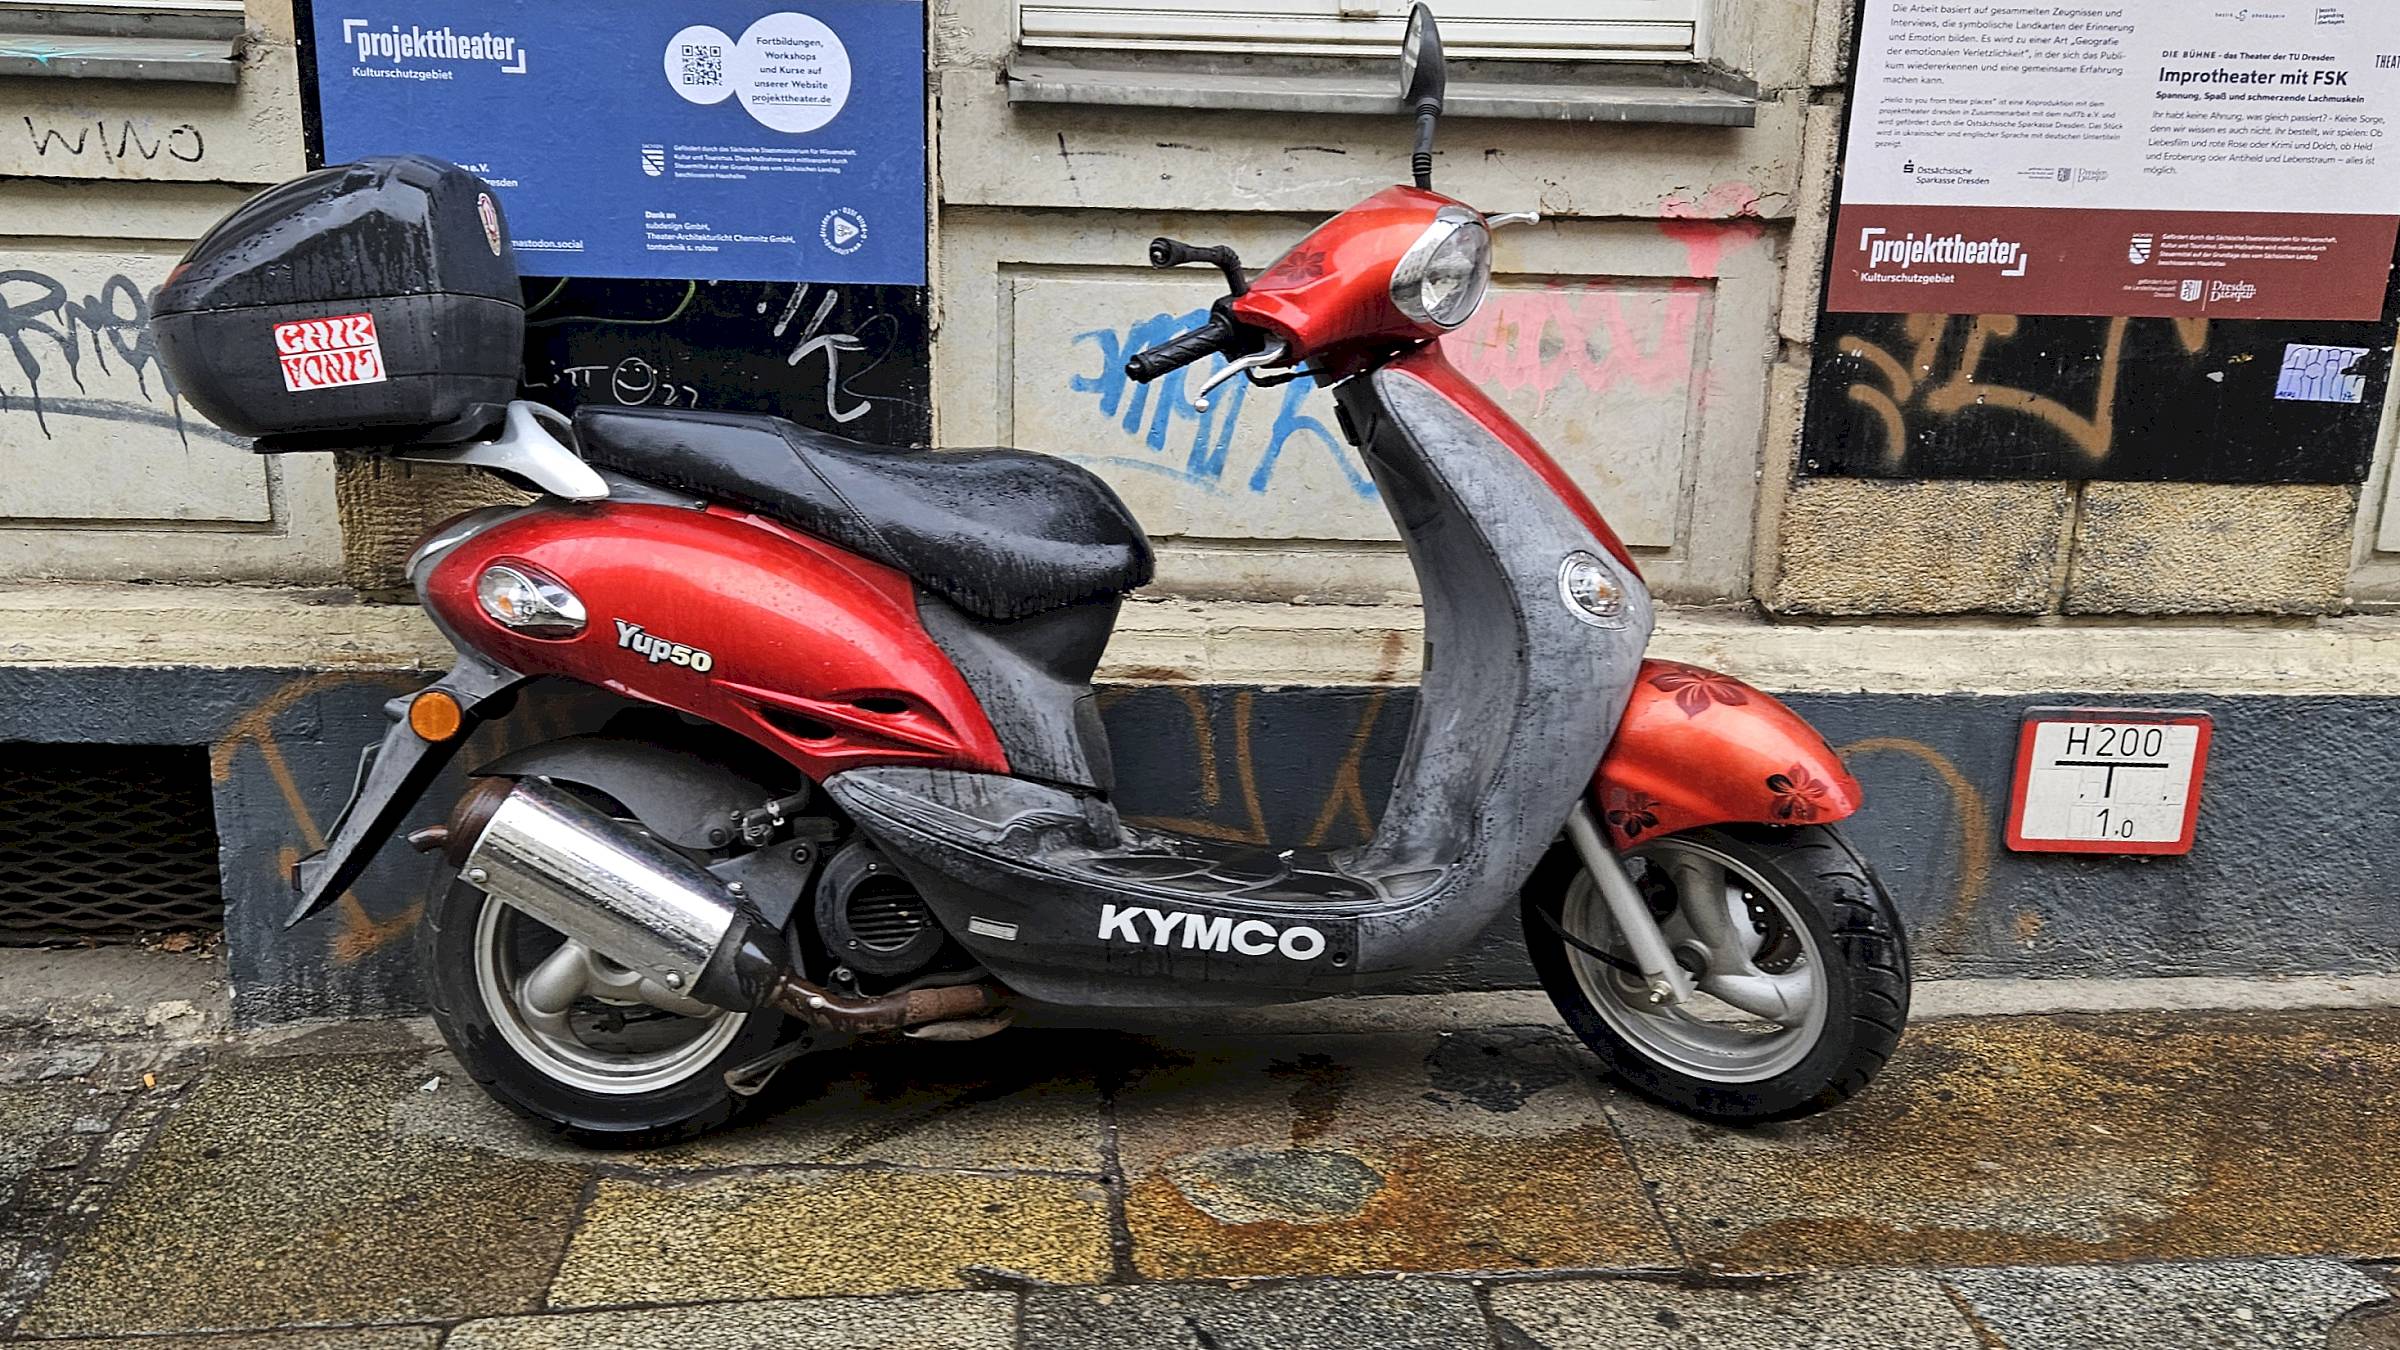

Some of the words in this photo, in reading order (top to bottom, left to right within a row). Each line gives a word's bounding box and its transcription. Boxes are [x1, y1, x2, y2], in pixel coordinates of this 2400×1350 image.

[1892, 4, 1907, 13] Die
[1910, 5, 1938, 13] Arbeit
[1940, 5, 1971, 14] basiert
[1974, 6, 1988, 14] auf
[1990, 7, 2050, 17] gesammelten
[2052, 8, 2103, 19] Zeugnissen
[2105, 9, 2122, 17] und
[1890, 19, 1939, 29] Interviews,
[1942, 20, 1956, 28] die
[1958, 20, 2013, 31] symbolische
[2015, 21, 2066, 30] Landkarten
[2068, 22, 2083, 30] der
[2085, 22, 2134, 34] Erinnerung
[357, 25, 515, 63] projekttheater
[756, 37, 824, 48] Fortbildungen,
[1888, 33, 1905, 41] und
[1908, 33, 1945, 42] Emotion
[1948, 34, 1978, 42] bilden.
[1981, 34, 1991, 43] Es
[1994, 35, 2013, 43] wird
[2029, 36, 2051, 44] einer
[2053, 36, 2068, 44] Art
[764, 52, 816, 61] Workshops
[1886, 47, 1902, 55] der
[1904, 47, 1960, 56] emotionalen
[2034, 49, 2042, 58] in
[2044, 50, 2060, 58] der
[2062, 50, 2080, 58] sich
[2082, 50, 2098, 58] das
[2182, 50, 2216, 59] BÜHNE
[352, 67, 453, 80] Kulturschutzgebiet
[1885, 61, 1904, 70] kum
[1907, 62, 1978, 71] wiedererkennen
[1981, 63, 1998, 71] und
[2000, 63, 2019, 72] eine
[2021, 64, 2077, 74] gemeinsame
[2079, 65, 2123, 76] Erfahrung
[1883, 76, 1918, 84] machen
[1920, 76, 1944, 84] kann.
[2159, 67, 2275, 86] Improtheater
[2280, 70, 2308, 85] mit
[2313, 71, 2348, 86] FSK
[792, 81, 828, 89] Website
[752, 94, 831, 104] projekttheater.de
[2156, 91, 2201, 101] Spannung,
[2204, 92, 2226, 102] Spaß
[2248, 93, 2305, 101] schmerzende
[2308, 94, 2364, 102] Lachmuskeln
[2210, 111, 2244, 122] Ahnung,
[2264, 113, 2289, 122] gleich
[2290, 114, 2327, 123] passiert?
[2359, 115, 2385, 125] Sorge,
[2288, 127, 2320, 137] bestellt,
[2337, 128, 2368, 138] spielen:
[2148, 139, 2189, 147] Liebesfilm
[2312, 142, 2338, 151] Dolch,
[2163, 153, 2206, 163] Eroberung
[2229, 154, 2263, 162] Antiheld
[2282, 155, 2336, 164] Lebenstraum
[1917, 166, 1973, 175] Ostsächsische
[2144, 166, 2177, 176] möglich.
[1916, 176, 1955, 185] Sparkasse
[1870, 233, 2020, 268] projekttheater
[1861, 272, 1955, 284] Kulturschutzgebiet
[616, 622, 712, 672] Yup50
[1098, 904, 1326, 960] KYMCO
